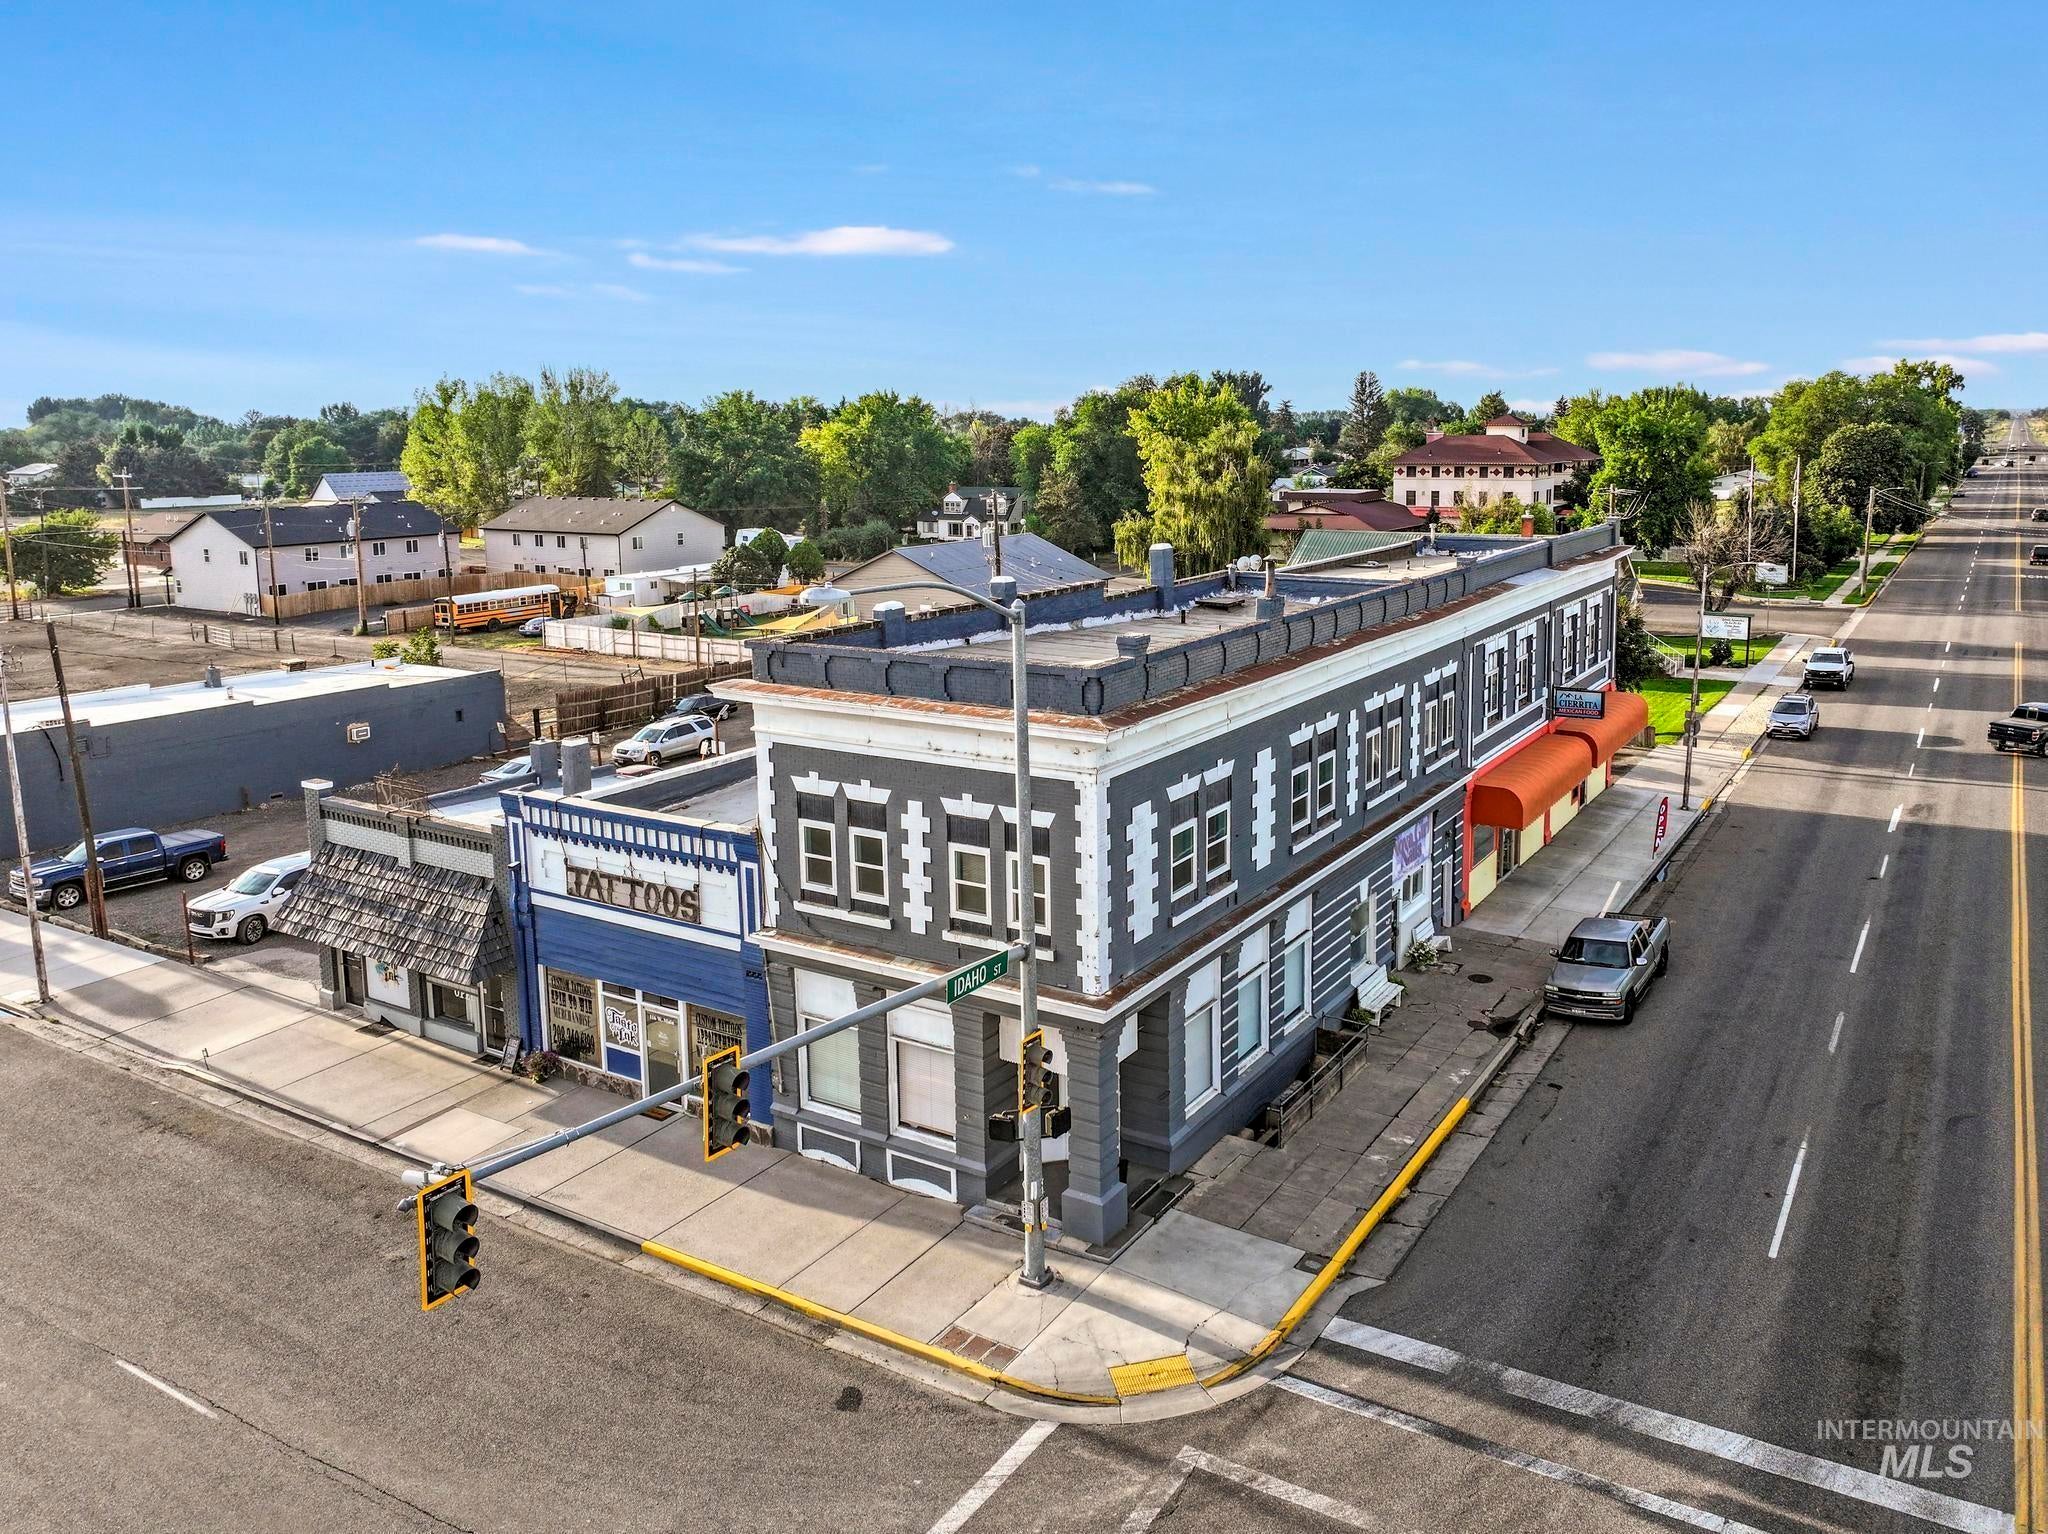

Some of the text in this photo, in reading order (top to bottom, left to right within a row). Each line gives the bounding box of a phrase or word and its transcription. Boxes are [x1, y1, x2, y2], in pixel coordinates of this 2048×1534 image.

[1559, 700, 1599, 709] CIERRITA
[1655, 804, 1666, 848] OPEN
[567, 866, 700, 923] TATTOOS
[571, 981, 592, 998] TATTOOS
[954, 963, 1002, 998] IDAHO ST
[606, 1007, 638, 1032] Taste
[696, 1013, 742, 1036] CUSTOM TATTOOS
[618, 1027, 639, 1046] Ink
